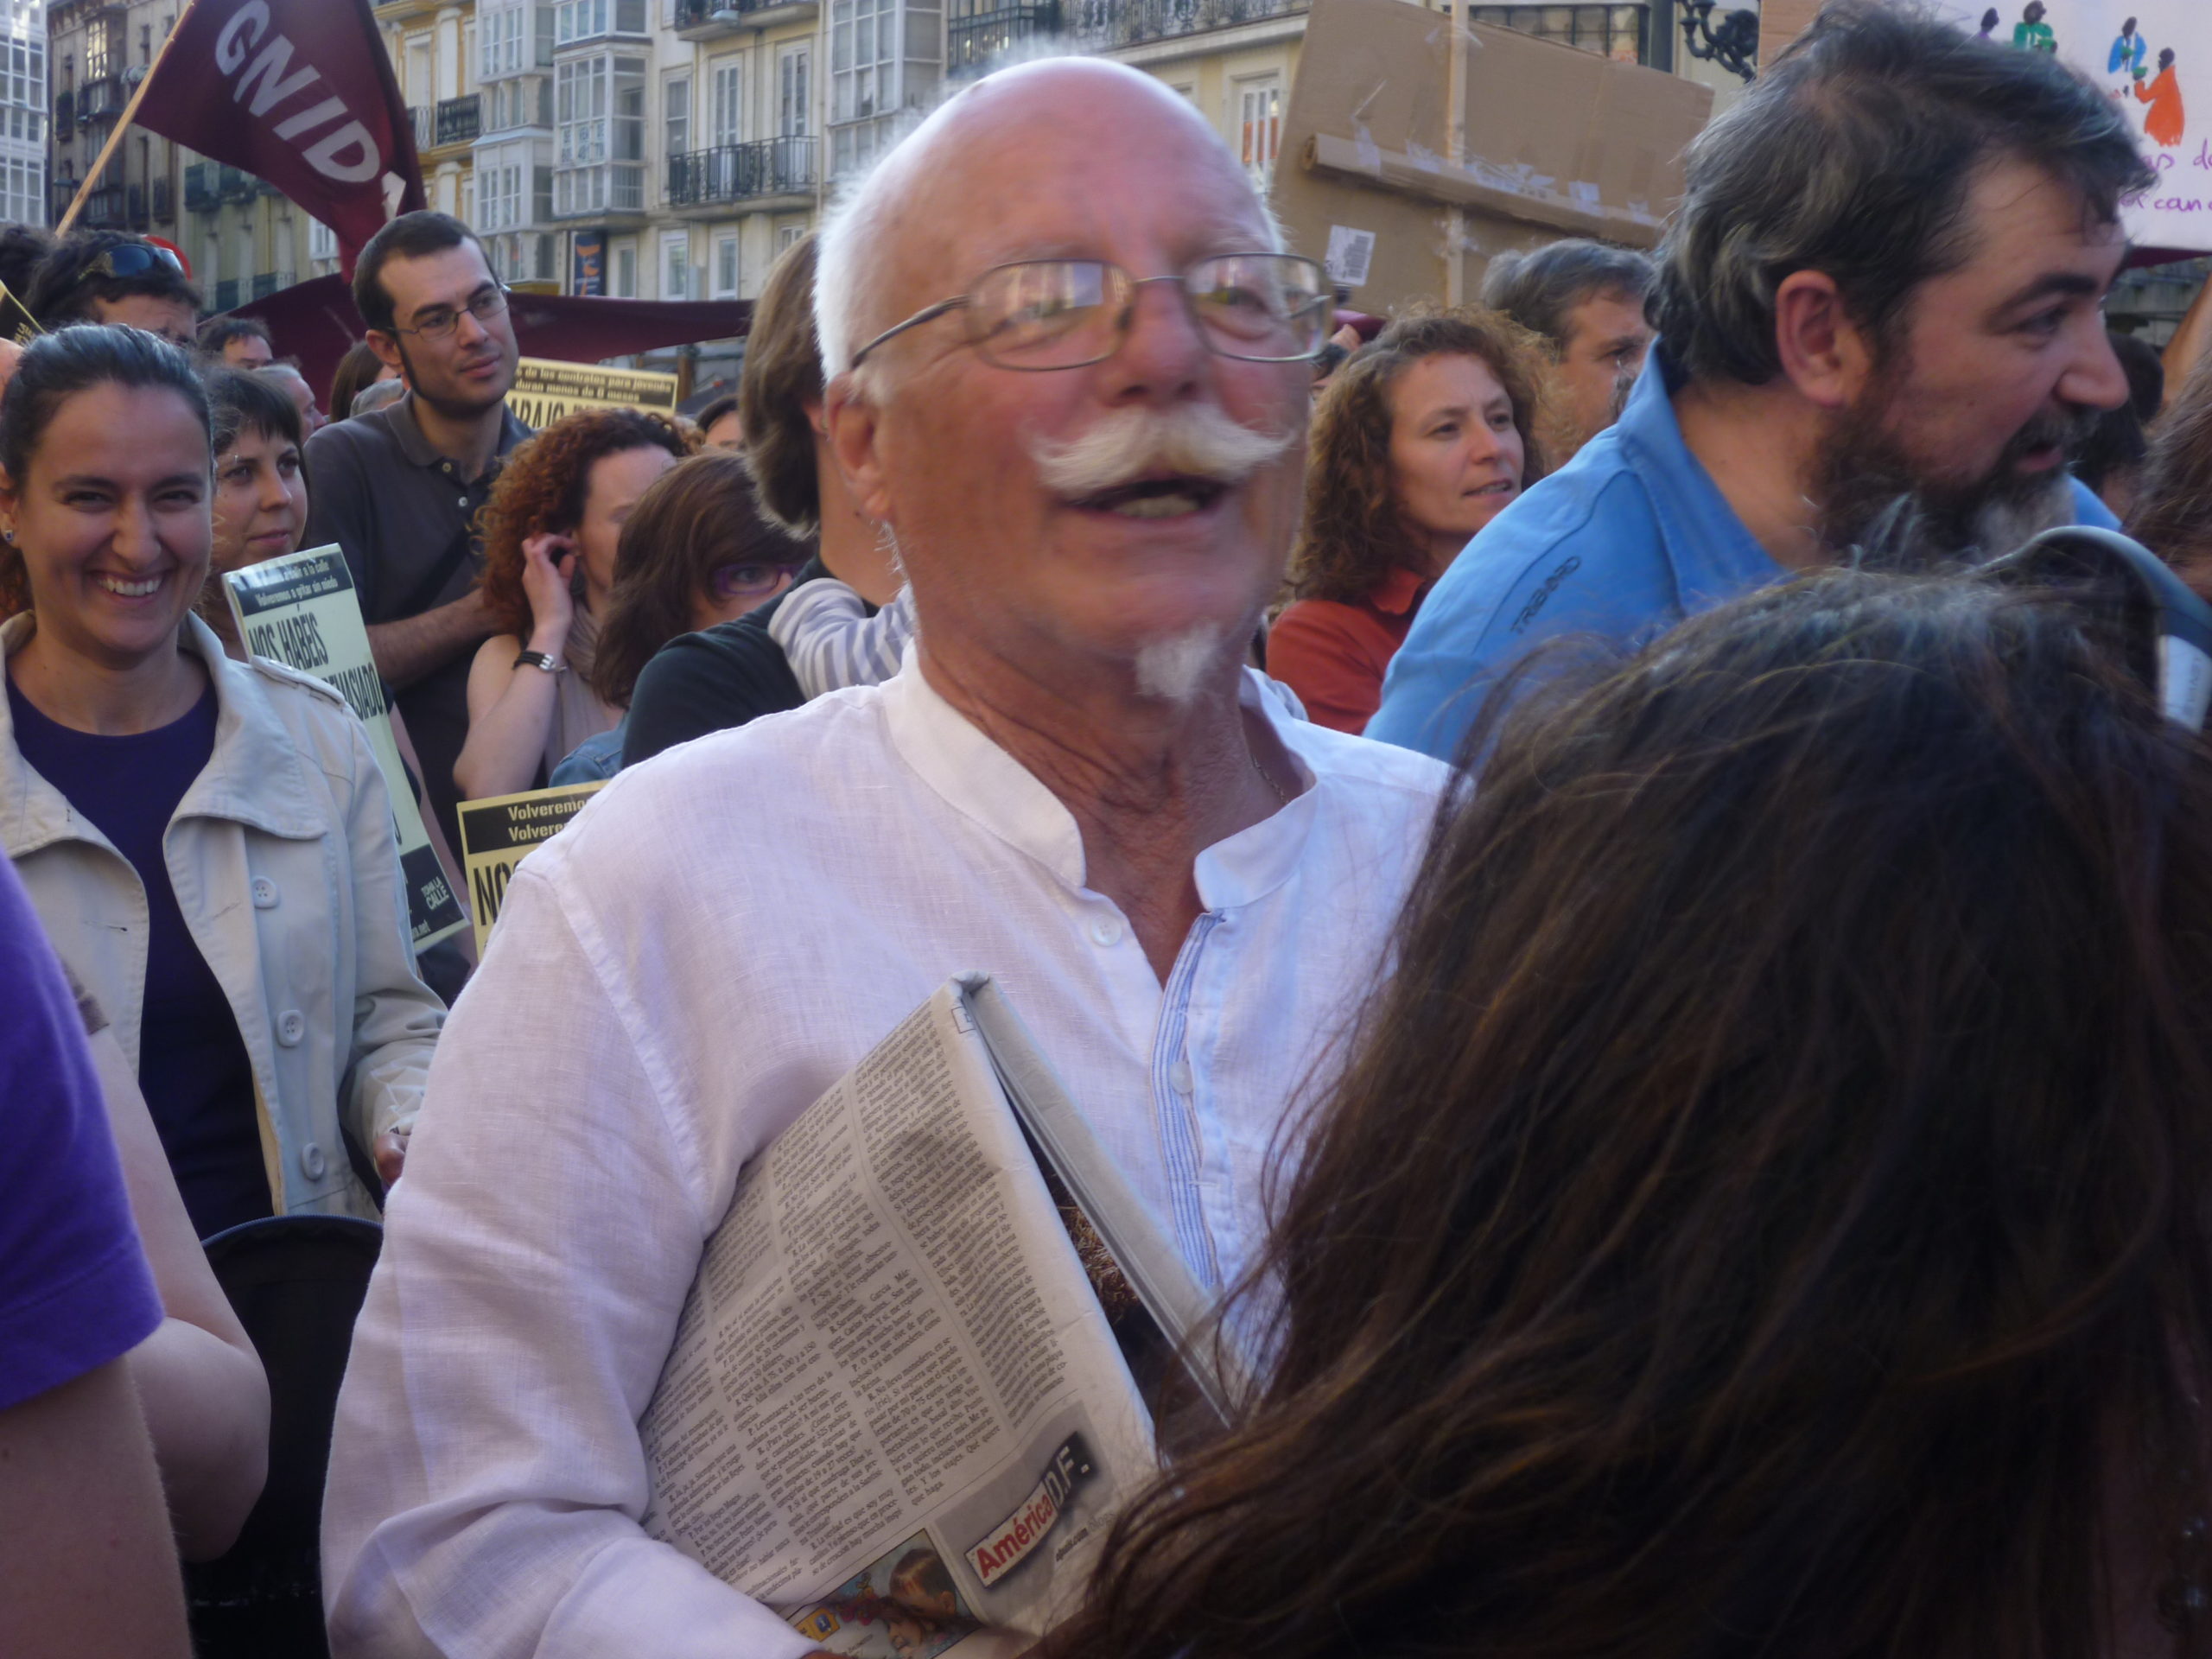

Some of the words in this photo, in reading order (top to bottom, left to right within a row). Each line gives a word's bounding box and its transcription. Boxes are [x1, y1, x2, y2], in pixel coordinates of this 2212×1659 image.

[508, 799, 588, 822] Volveremo
[508, 821, 569, 842] Volvere
[425, 885, 449, 910] CALLE
[976, 1493, 1054, 1580] América
